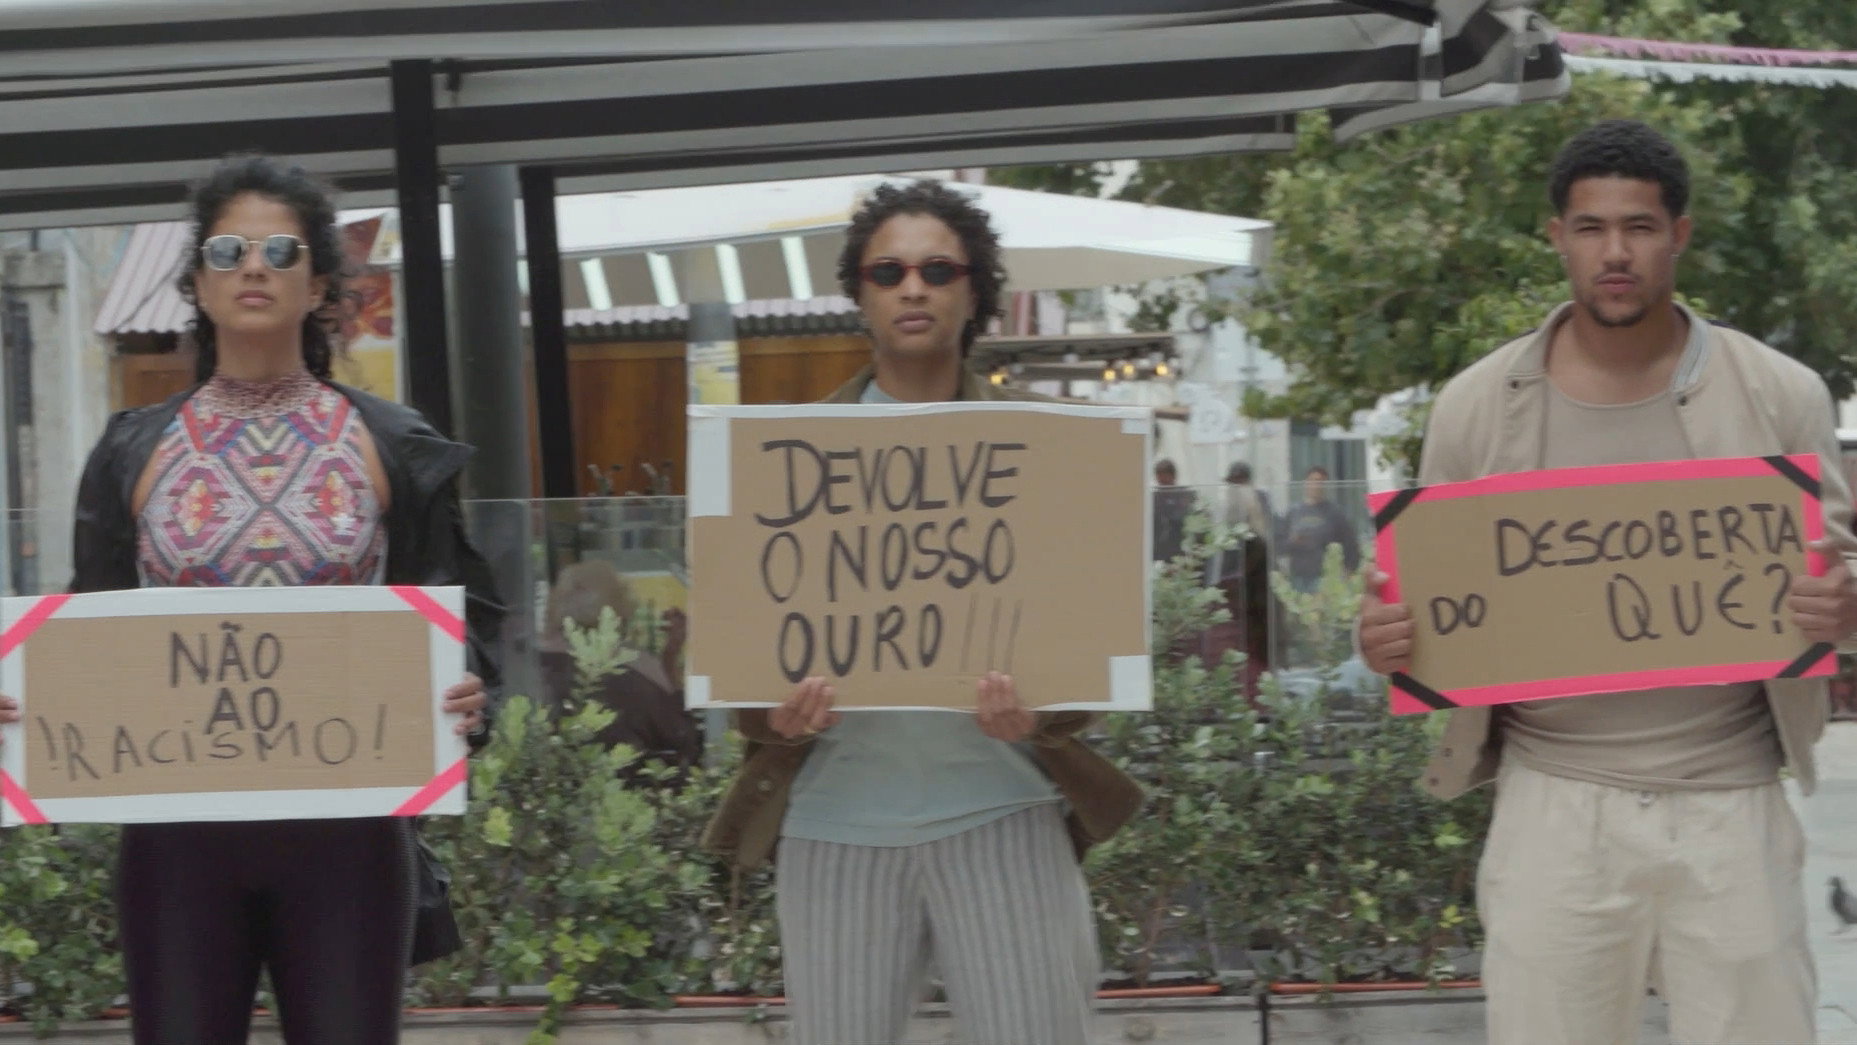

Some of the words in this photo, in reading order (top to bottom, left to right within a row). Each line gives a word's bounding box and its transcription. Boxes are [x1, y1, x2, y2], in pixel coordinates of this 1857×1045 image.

[754, 438, 1027, 527] DEVOLVE
[761, 531, 803, 603] O
[826, 518, 1016, 602] NOSSO
[1494, 503, 1803, 576] DESCOBERTA
[1430, 592, 1487, 635] DO
[1606, 559, 1793, 642] QUÊ?
[168, 621, 283, 688] NÃO
[205, 686, 281, 736] AO
